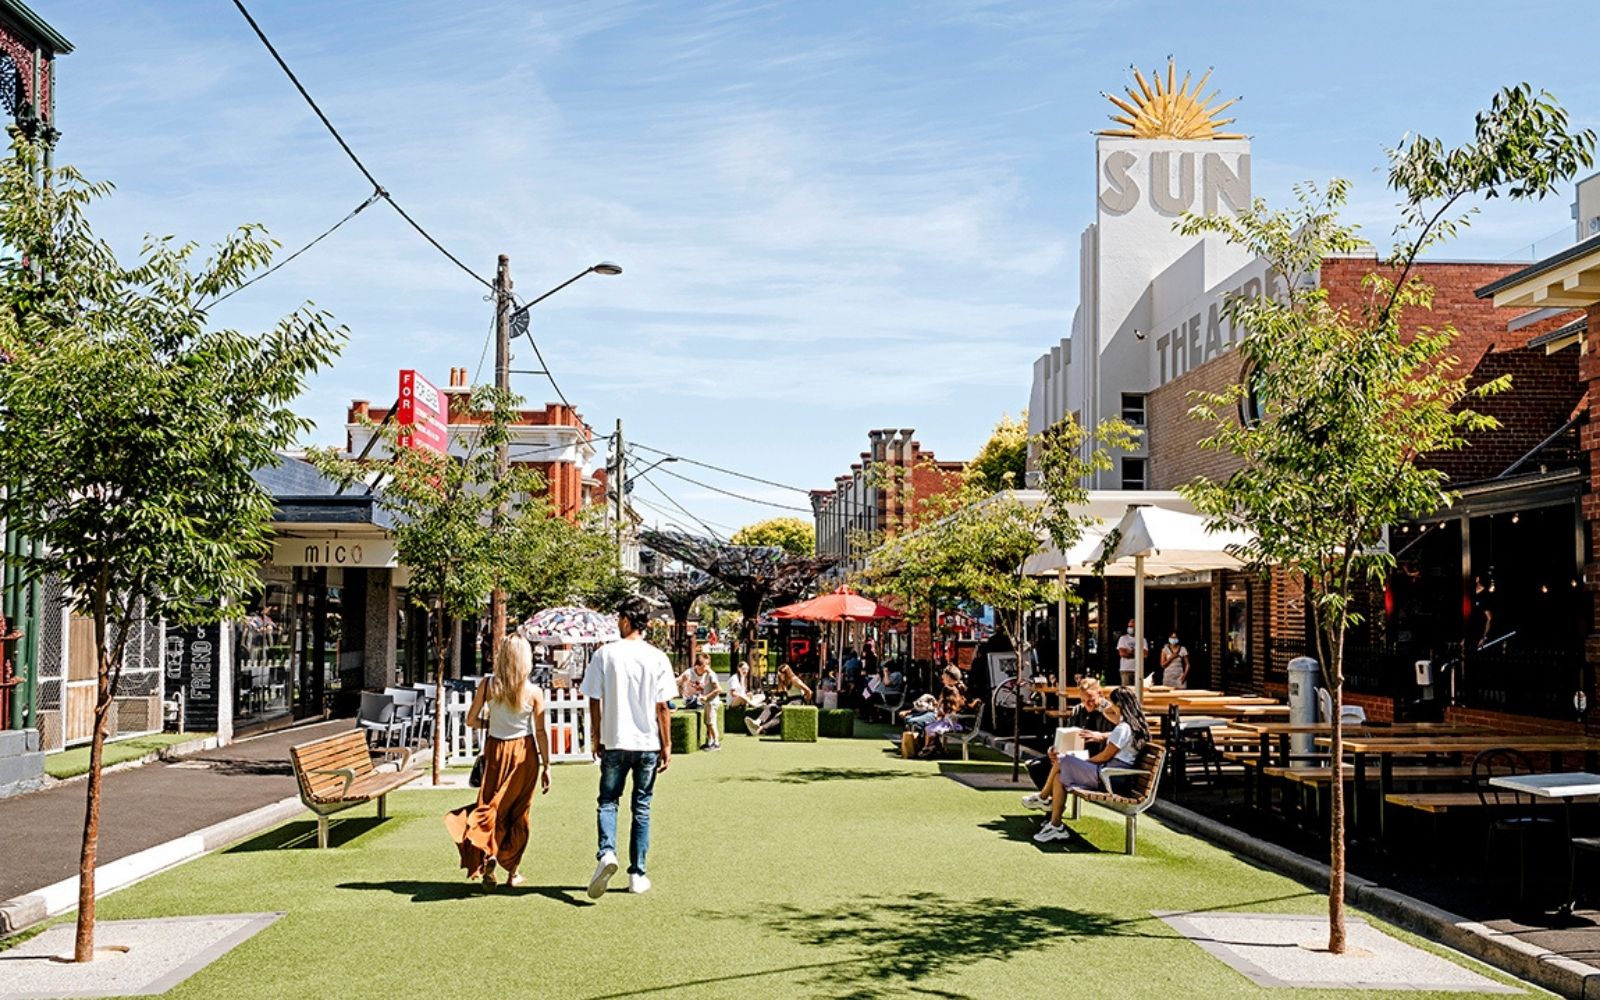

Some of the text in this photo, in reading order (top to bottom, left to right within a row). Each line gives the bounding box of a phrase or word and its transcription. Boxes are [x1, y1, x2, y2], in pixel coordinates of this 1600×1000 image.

[1100, 151, 1250, 217] SUN
[402, 374, 411, 409] FOR
[305, 541, 362, 563] mico
[190, 640, 213, 699] FRIEND
